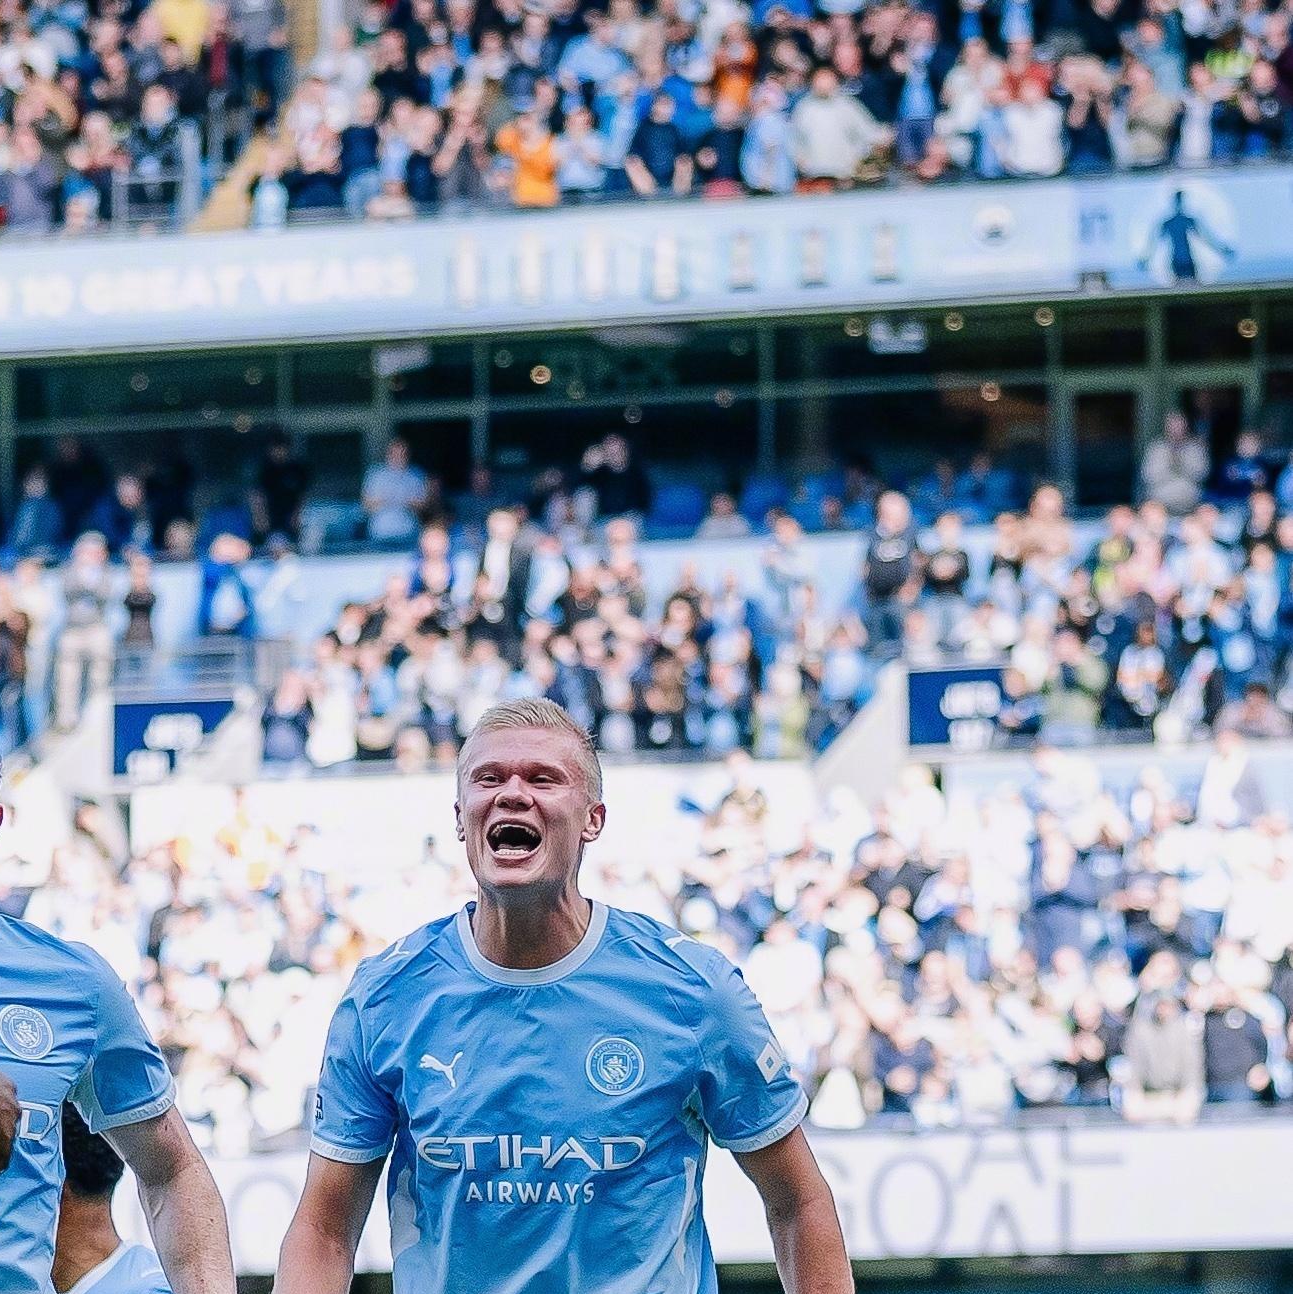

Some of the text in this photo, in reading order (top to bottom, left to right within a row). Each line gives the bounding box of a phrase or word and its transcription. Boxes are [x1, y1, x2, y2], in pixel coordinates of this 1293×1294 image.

[78, 263, 246, 316] GREAT
[252, 255, 418, 306] YEARS
[416, 1133, 648, 1172] ETIHAD
[465, 1180, 596, 1206] AIRWAYS
